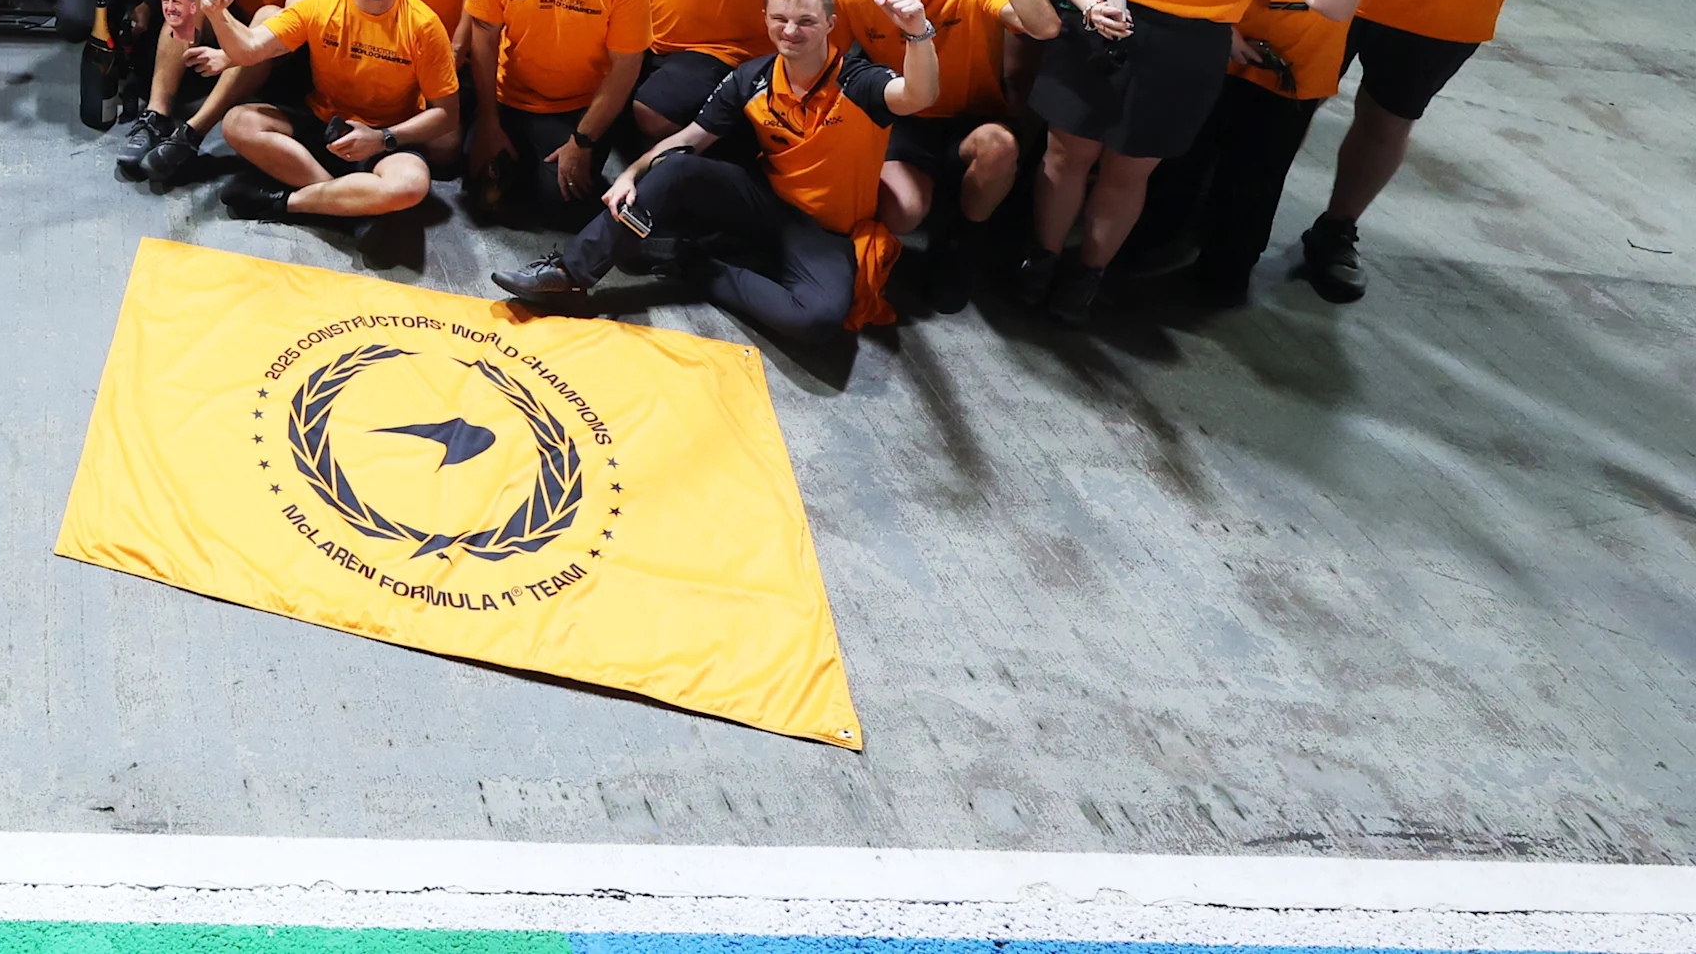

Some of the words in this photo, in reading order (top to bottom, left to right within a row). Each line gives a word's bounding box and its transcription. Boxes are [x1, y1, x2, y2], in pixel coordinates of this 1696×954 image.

[264, 349, 301, 381] 2025
[297, 314, 448, 351] CONSTRUCTORS'
[451, 323, 520, 358] WORLD
[520, 354, 614, 447] CHAMPIONS
[281, 502, 377, 581] McLAREN
[377, 573, 499, 612] FORMULA
[529, 562, 589, 603] TEAM
